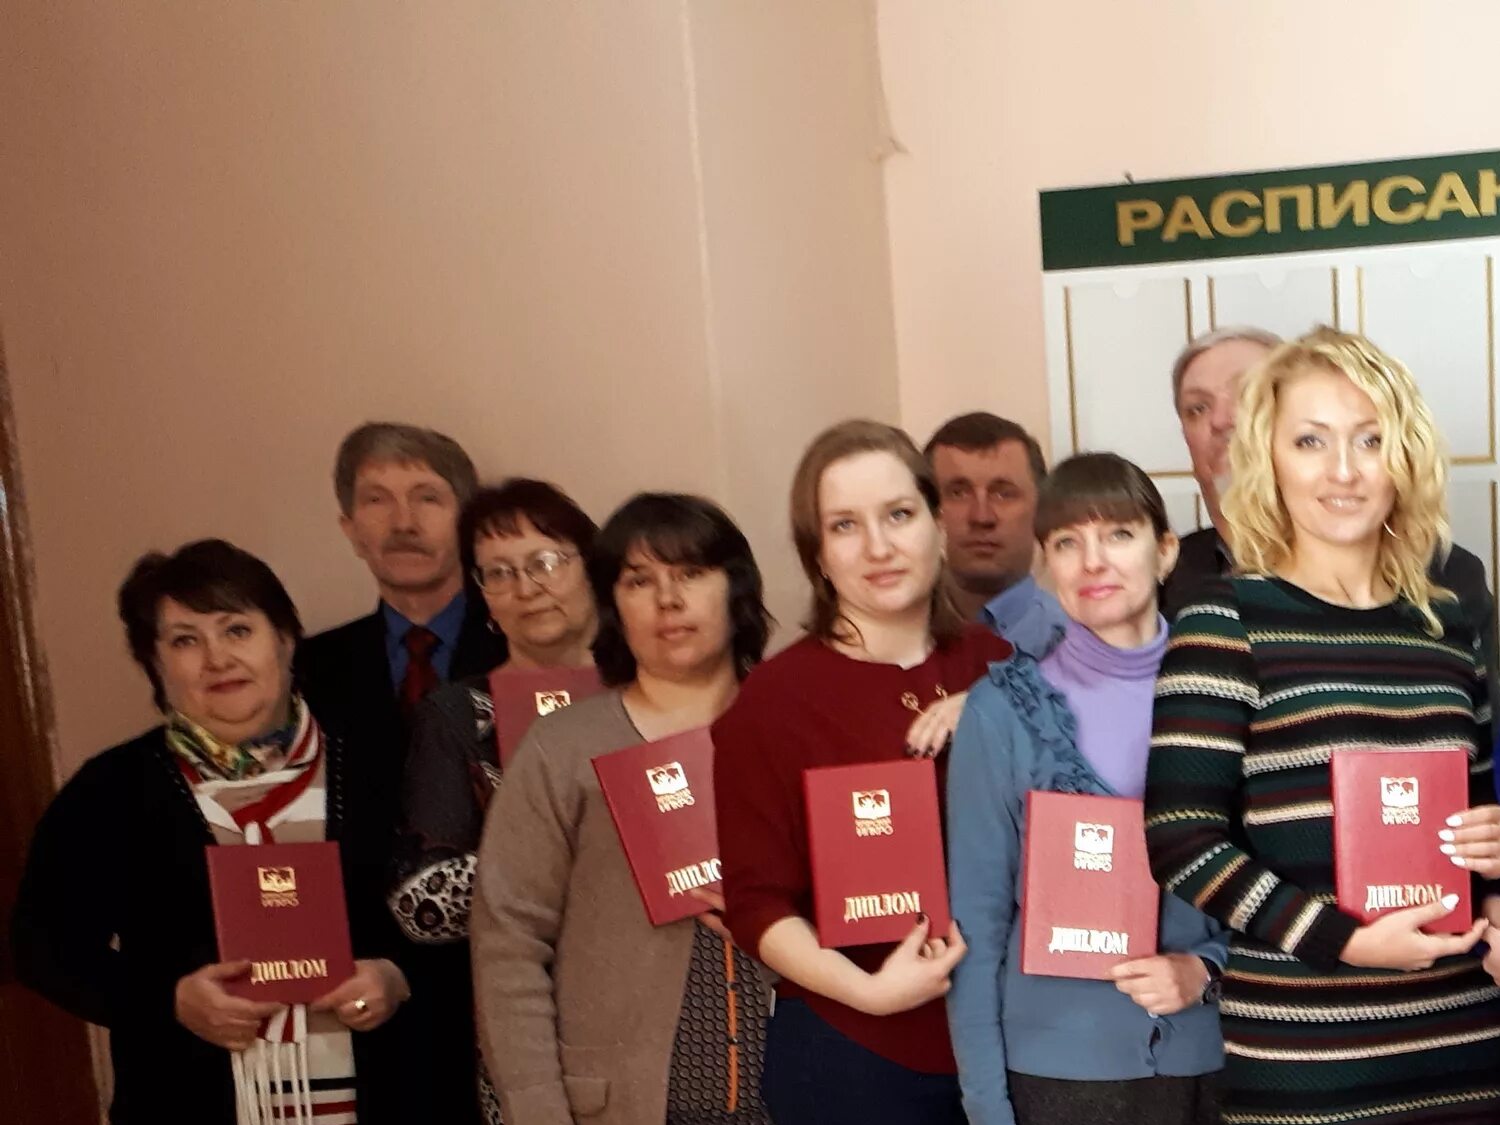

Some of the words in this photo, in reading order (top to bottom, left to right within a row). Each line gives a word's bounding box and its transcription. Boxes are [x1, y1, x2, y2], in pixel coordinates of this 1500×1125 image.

[665, 858, 723, 898] ДИПЛО
[843, 891, 922, 924] ДИПЛОМ
[1364, 884, 1444, 912] ДИПЛОМ
[1048, 926, 1130, 956] ДИПЛОМ
[250, 958, 329, 986] ДИПЛОМ
